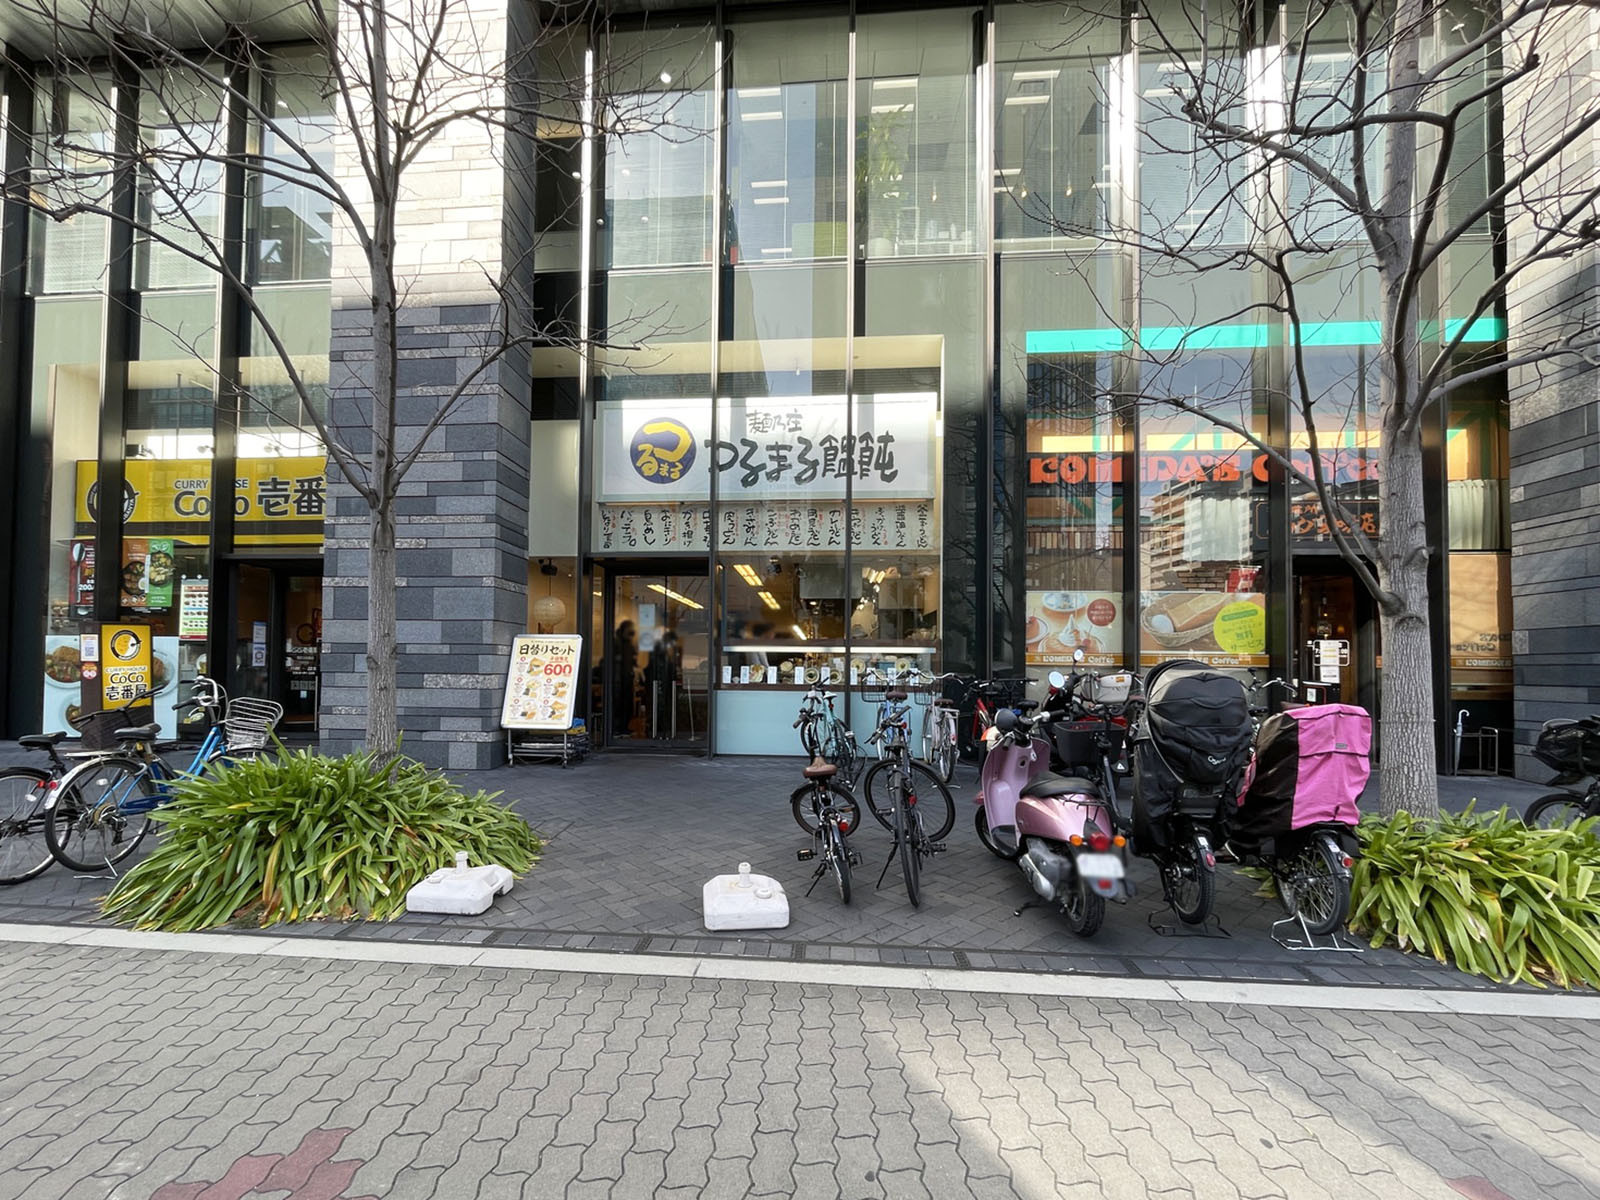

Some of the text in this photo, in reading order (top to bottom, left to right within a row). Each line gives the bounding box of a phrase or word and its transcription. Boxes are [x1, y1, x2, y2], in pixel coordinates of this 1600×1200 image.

[174, 480, 209, 489] CURRY
[174, 490, 250, 516] Coo
[110, 672, 144, 684] CoCo
